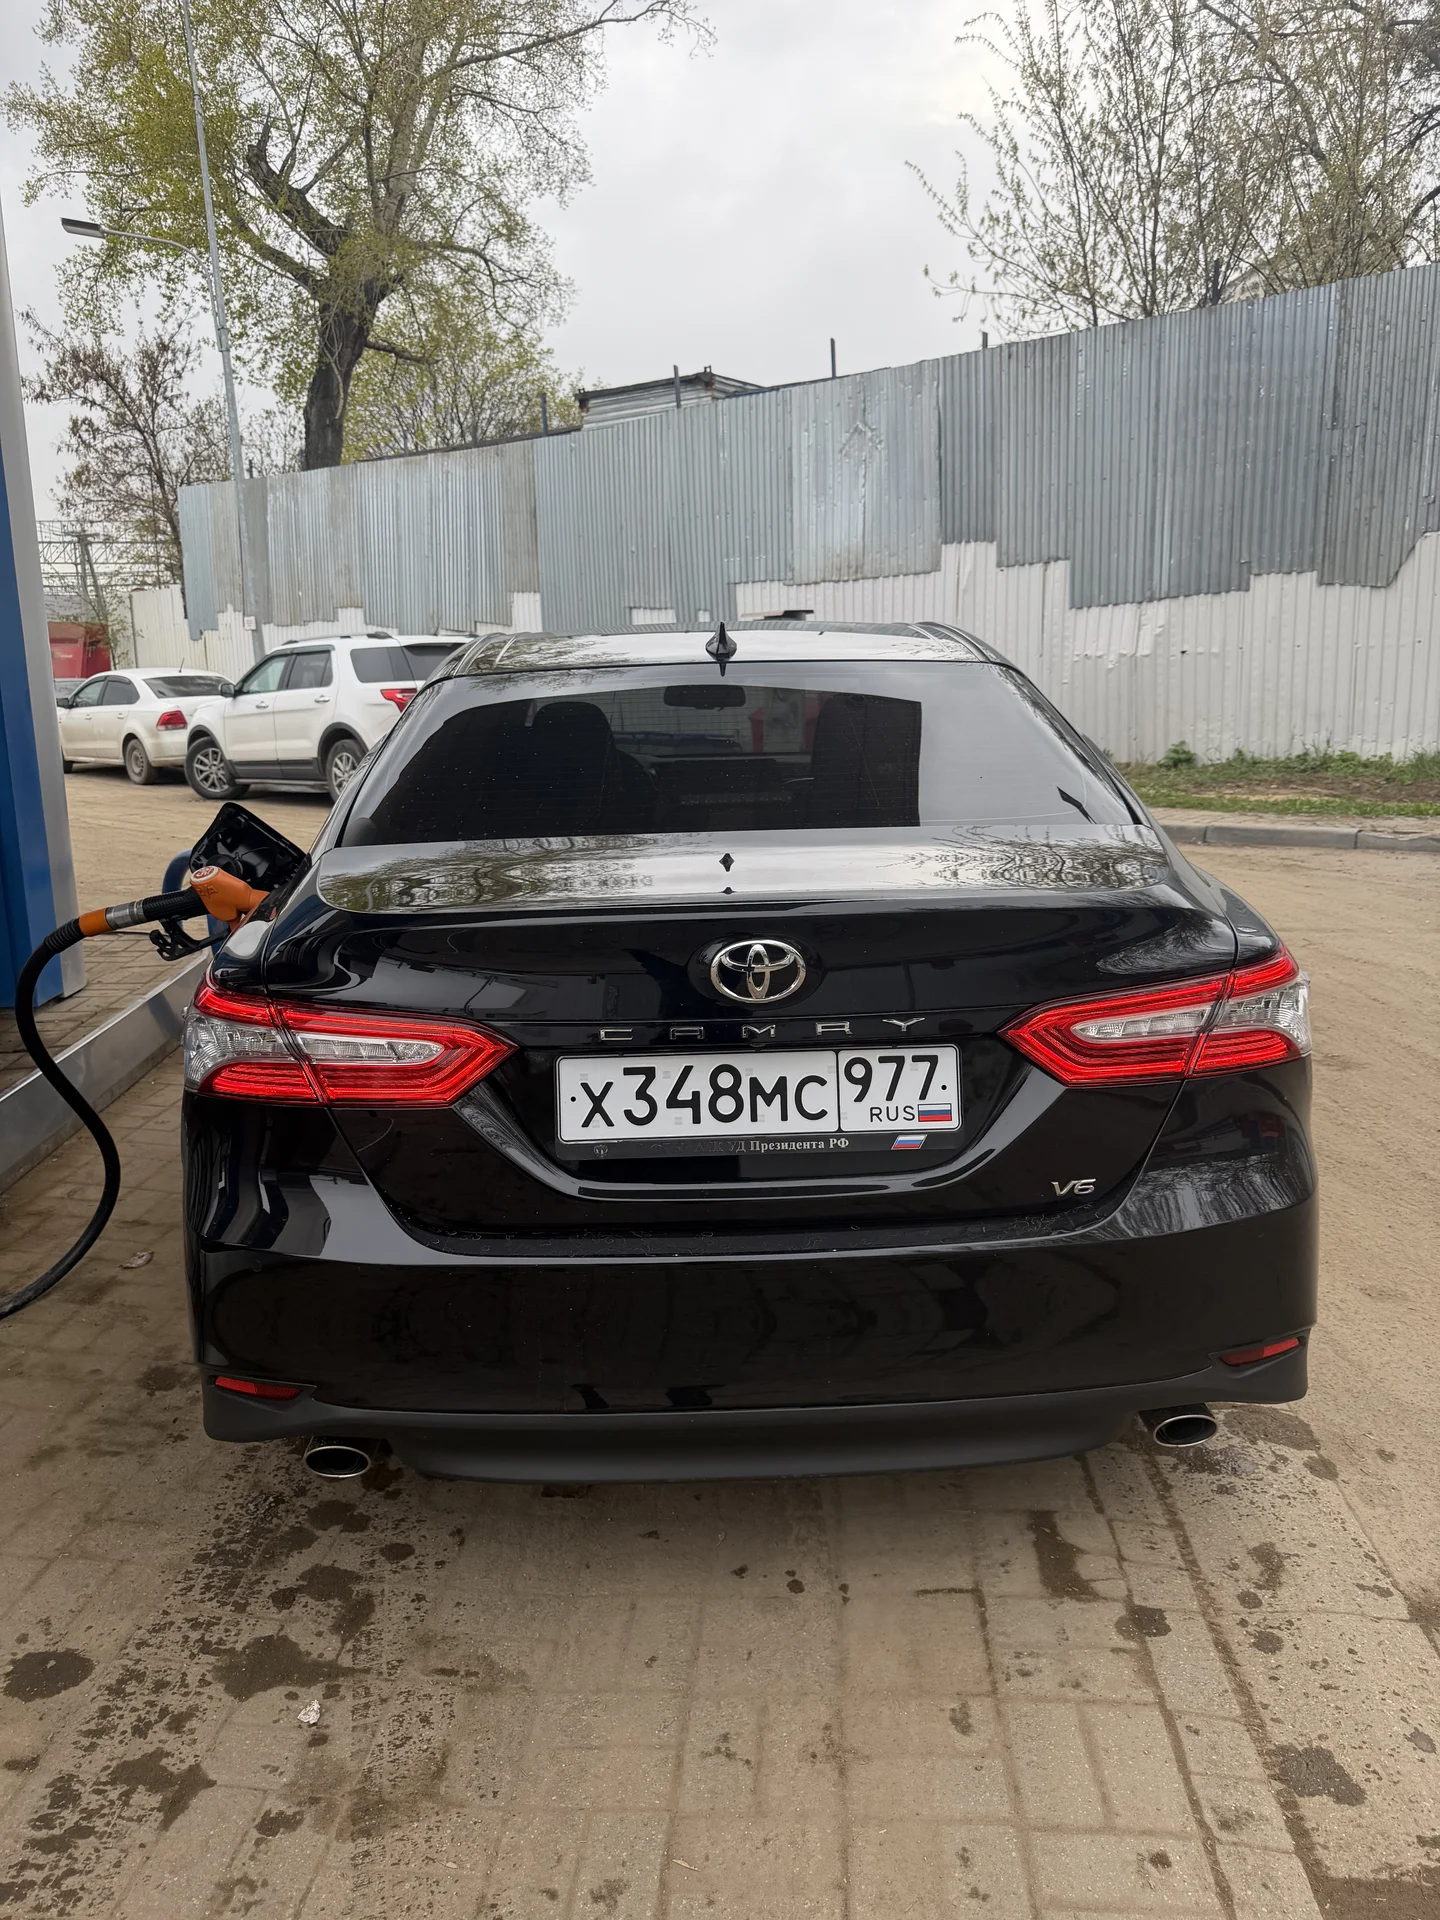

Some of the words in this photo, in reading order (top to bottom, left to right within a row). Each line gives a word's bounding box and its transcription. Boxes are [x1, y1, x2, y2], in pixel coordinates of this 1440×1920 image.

[599, 1017, 926, 1041] CAMRY
[843, 1055, 940, 1102] 977
[869, 1105, 916, 1123] RUS
[750, 1139, 825, 1153] Президента
[828, 1137, 850, 1150] РФ
[1051, 1178, 1097, 1197] V6
